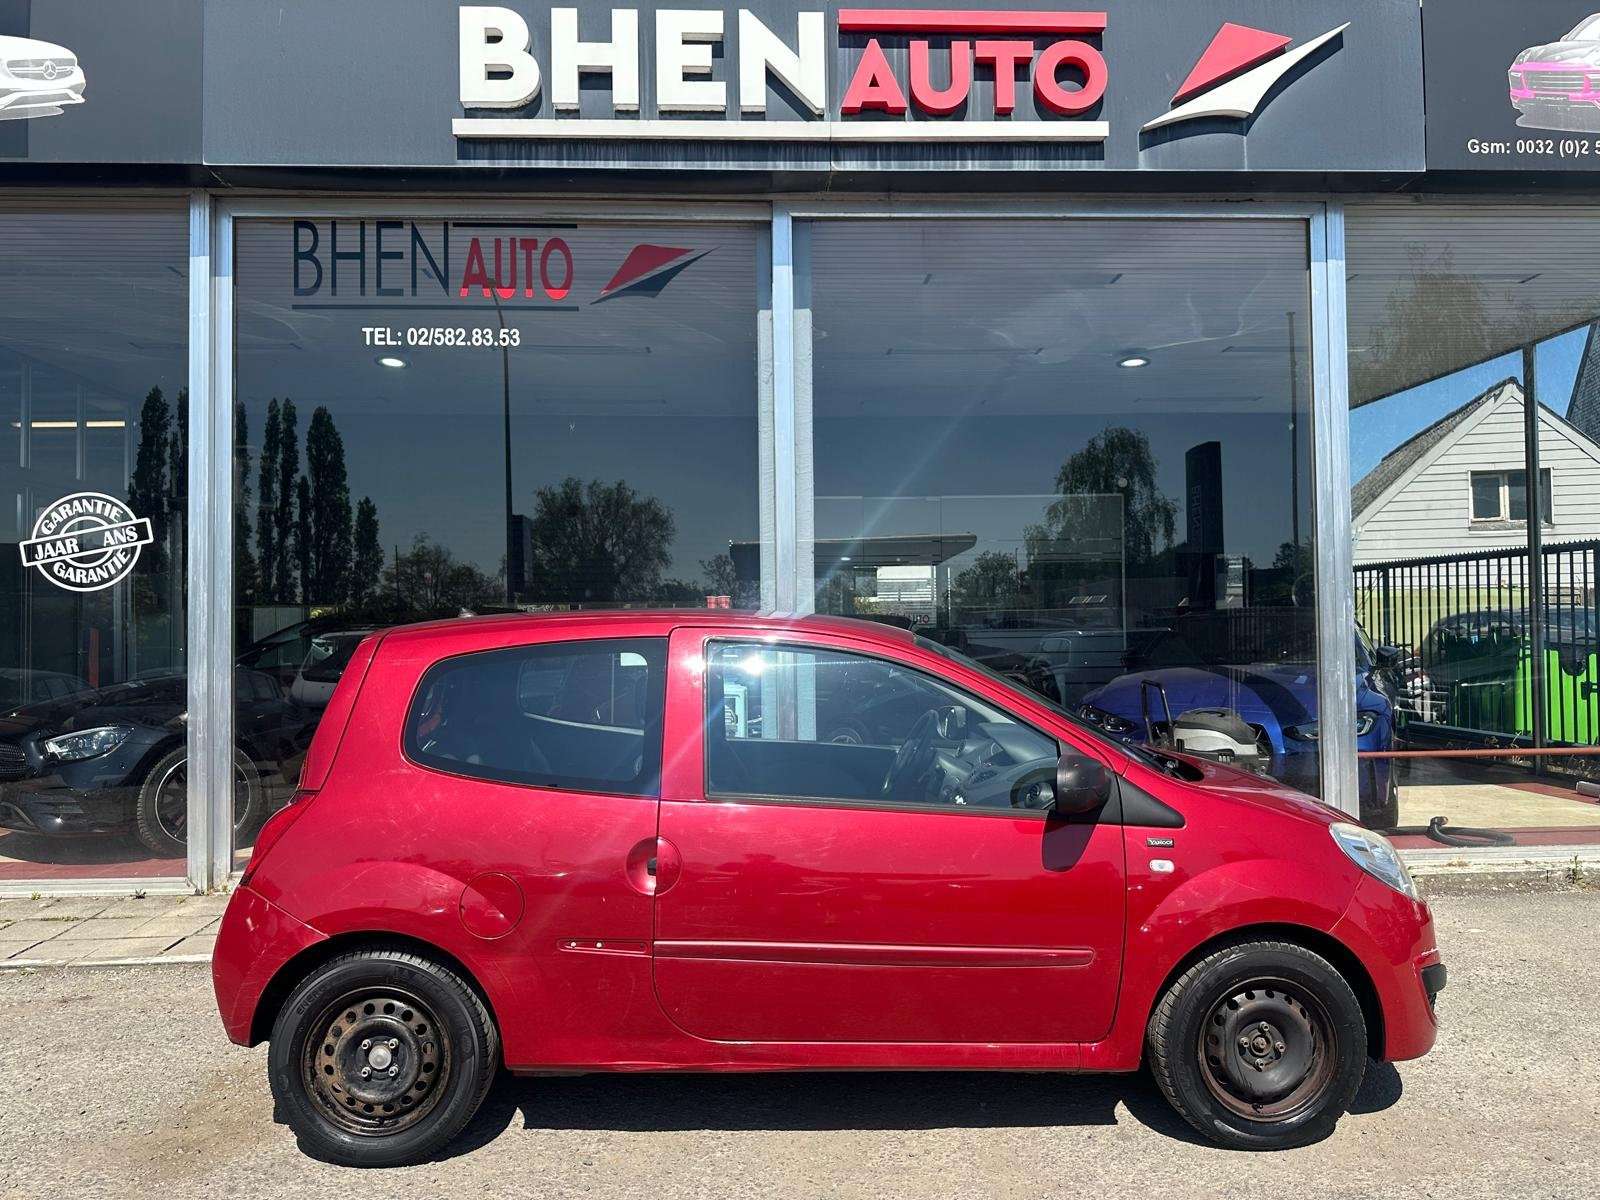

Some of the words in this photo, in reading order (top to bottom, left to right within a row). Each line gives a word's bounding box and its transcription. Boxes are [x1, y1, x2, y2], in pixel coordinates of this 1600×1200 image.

[459, 6, 825, 114] BHEN
[840, 38, 1109, 115] AUTO
[1466, 138, 1511, 154] Gsm:
[1516, 139, 1554, 154] 0032
[1559, 139, 1589, 158] (0)2
[293, 220, 450, 297] BHEN
[460, 237, 574, 300] AUTO
[362, 327, 402, 346] TEL:
[406, 327, 521, 347] 02/582.83.53
[41, 498, 124, 535] GARANTIE
[34, 537, 80, 561] JAAR
[103, 525, 139, 547] ANS
[53, 549, 131, 584] GARANTIE
